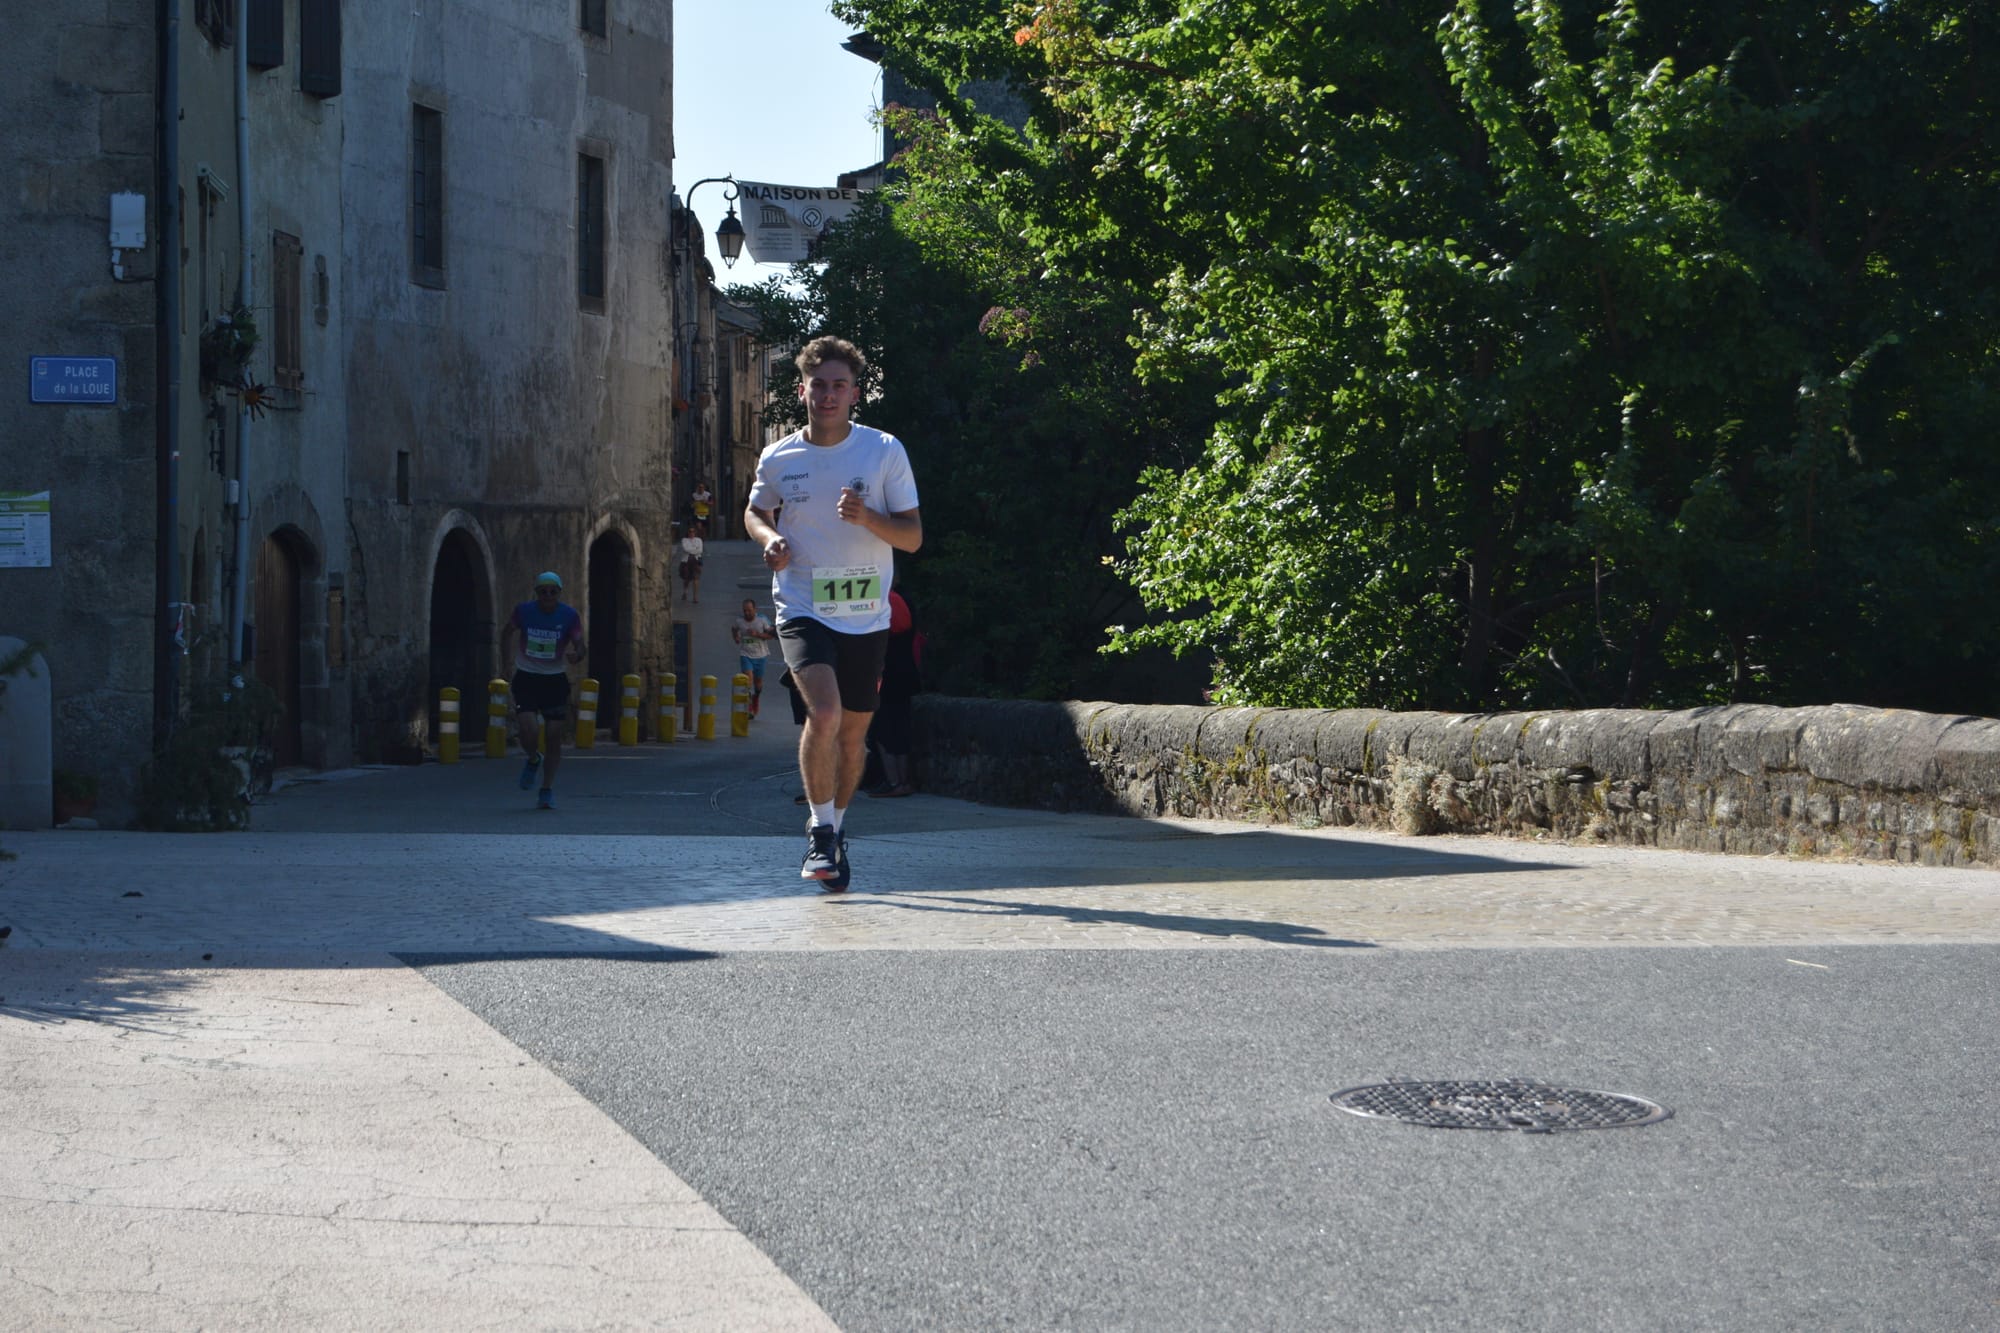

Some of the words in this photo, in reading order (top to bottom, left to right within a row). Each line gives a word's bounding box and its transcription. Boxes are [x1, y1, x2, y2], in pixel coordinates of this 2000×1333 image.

[745, 187, 822, 200] MAISON
[827, 189, 851, 200] DE
[65, 366, 98, 377] PLACE
[54, 384, 66, 394] de
[70, 384, 79, 394] la
[83, 384, 110, 394] LOUE
[824, 579, 871, 600] 117
[538, 643, 545, 652] 3
